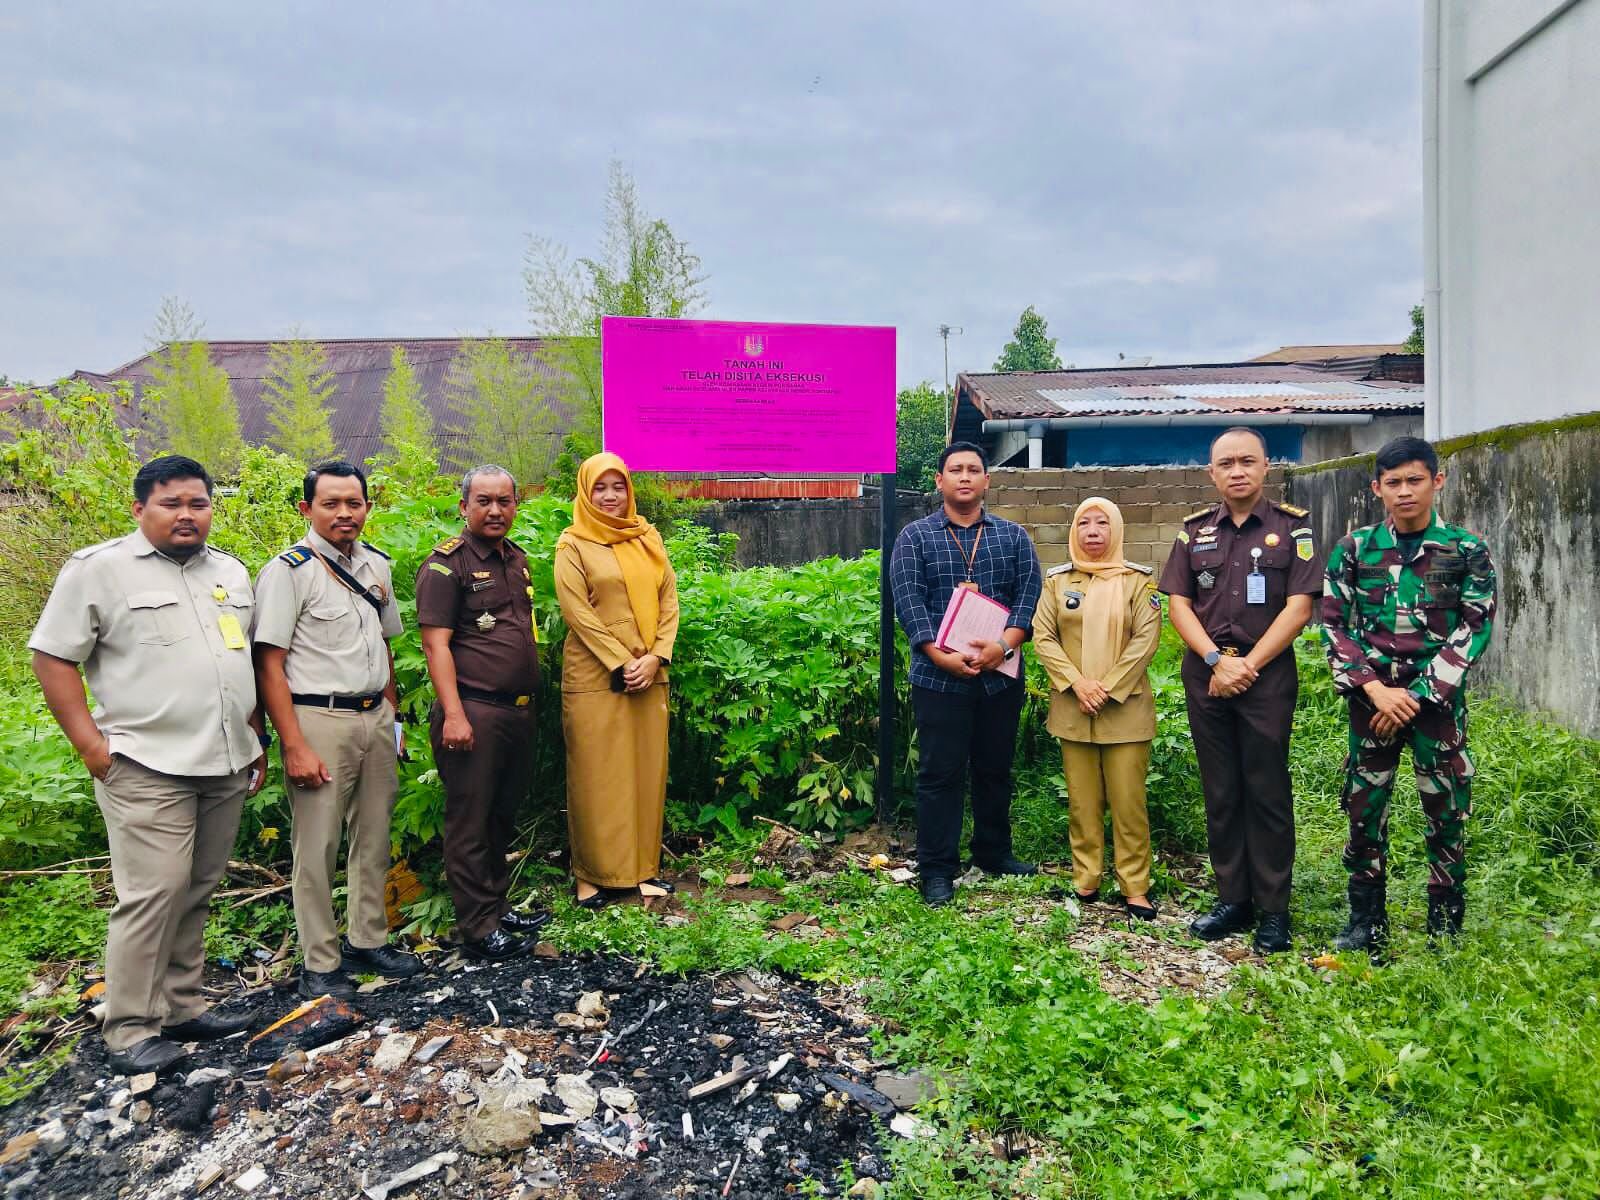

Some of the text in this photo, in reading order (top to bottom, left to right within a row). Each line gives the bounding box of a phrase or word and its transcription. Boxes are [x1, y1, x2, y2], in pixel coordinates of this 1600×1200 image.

[724, 359, 784, 370] TANAH INI
[681, 370, 825, 384] TELAH DISITA EKSEKUSI
